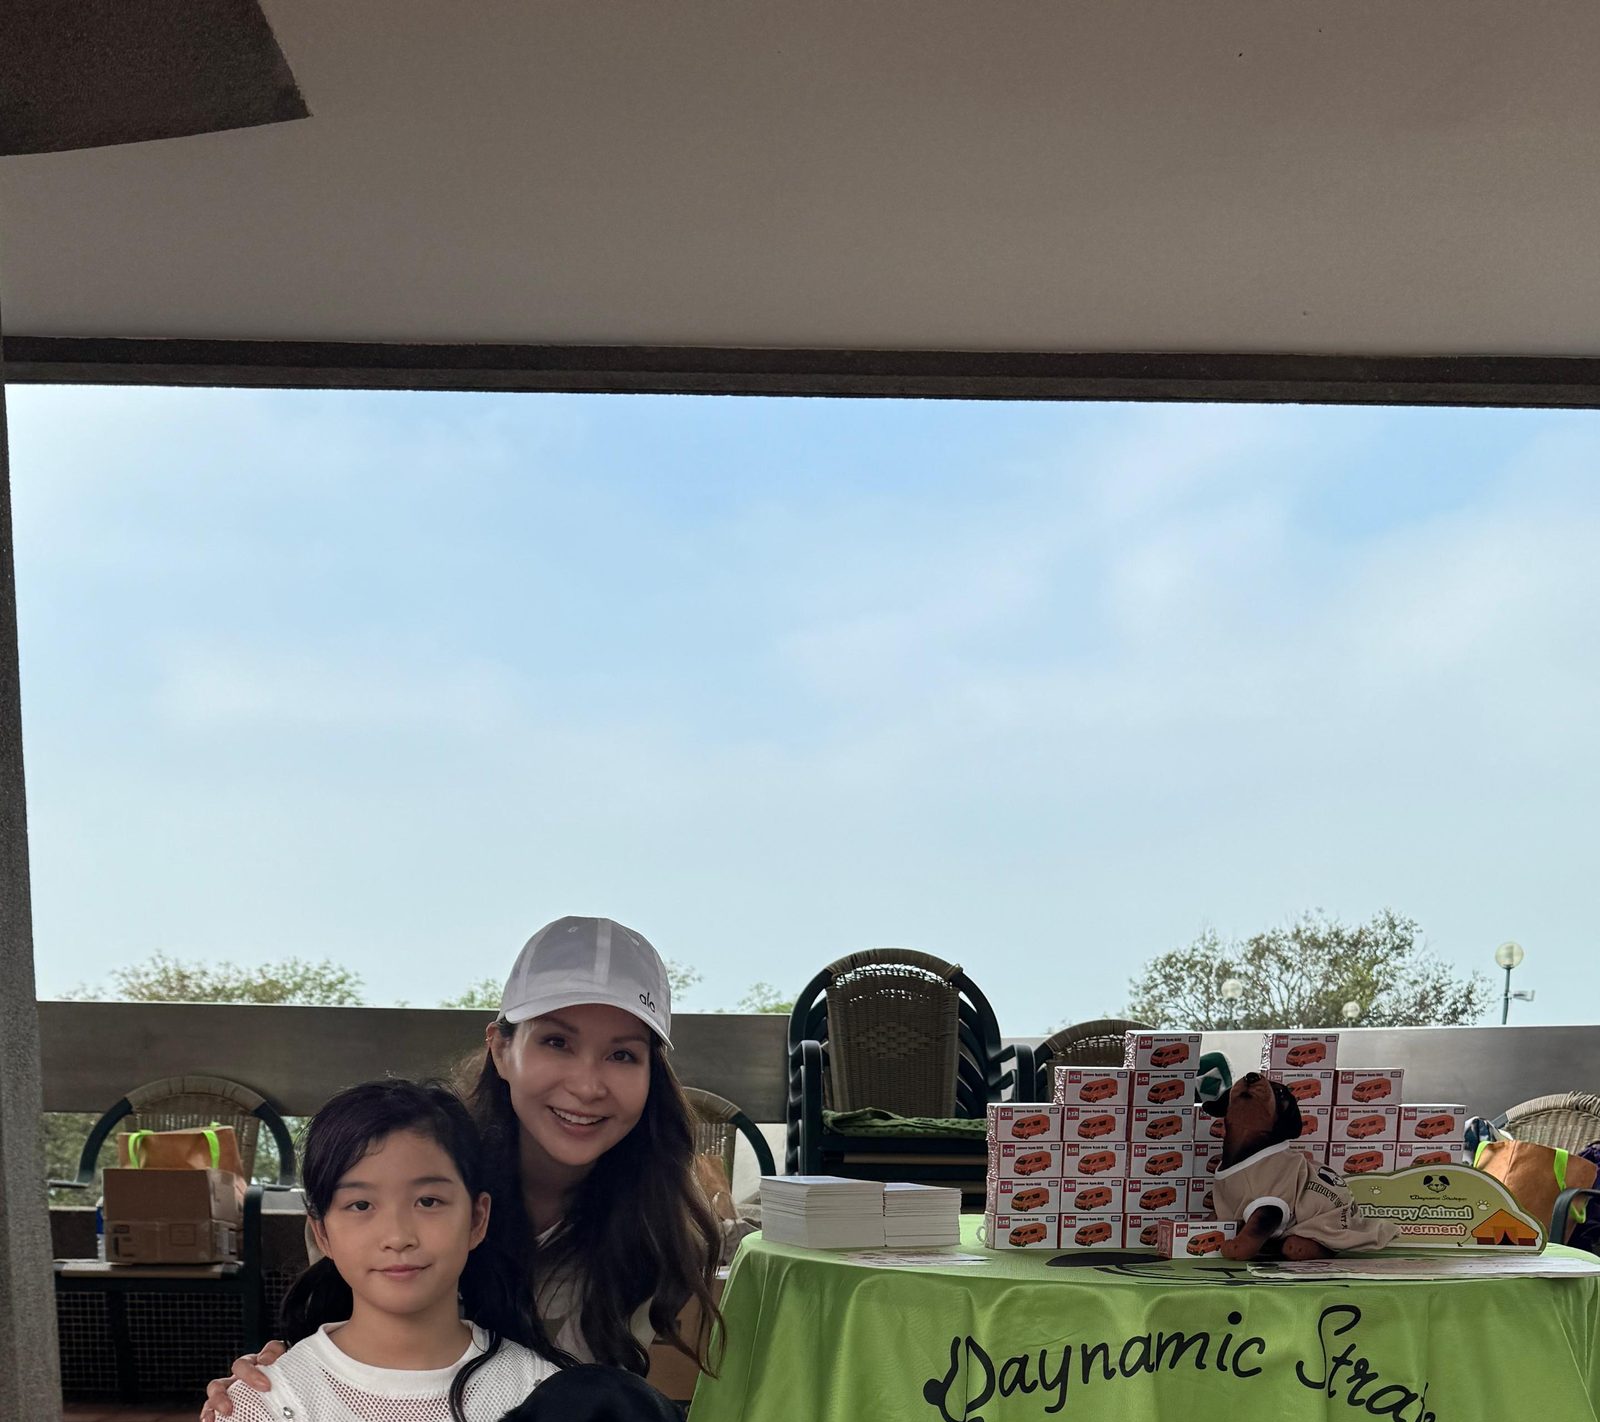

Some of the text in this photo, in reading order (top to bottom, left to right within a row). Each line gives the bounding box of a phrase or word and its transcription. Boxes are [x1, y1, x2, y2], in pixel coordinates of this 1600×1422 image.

[1360, 1205, 1419, 1220] Therapy
[1419, 1205, 1472, 1219] Animal
[1400, 1223, 1466, 1235] werment
